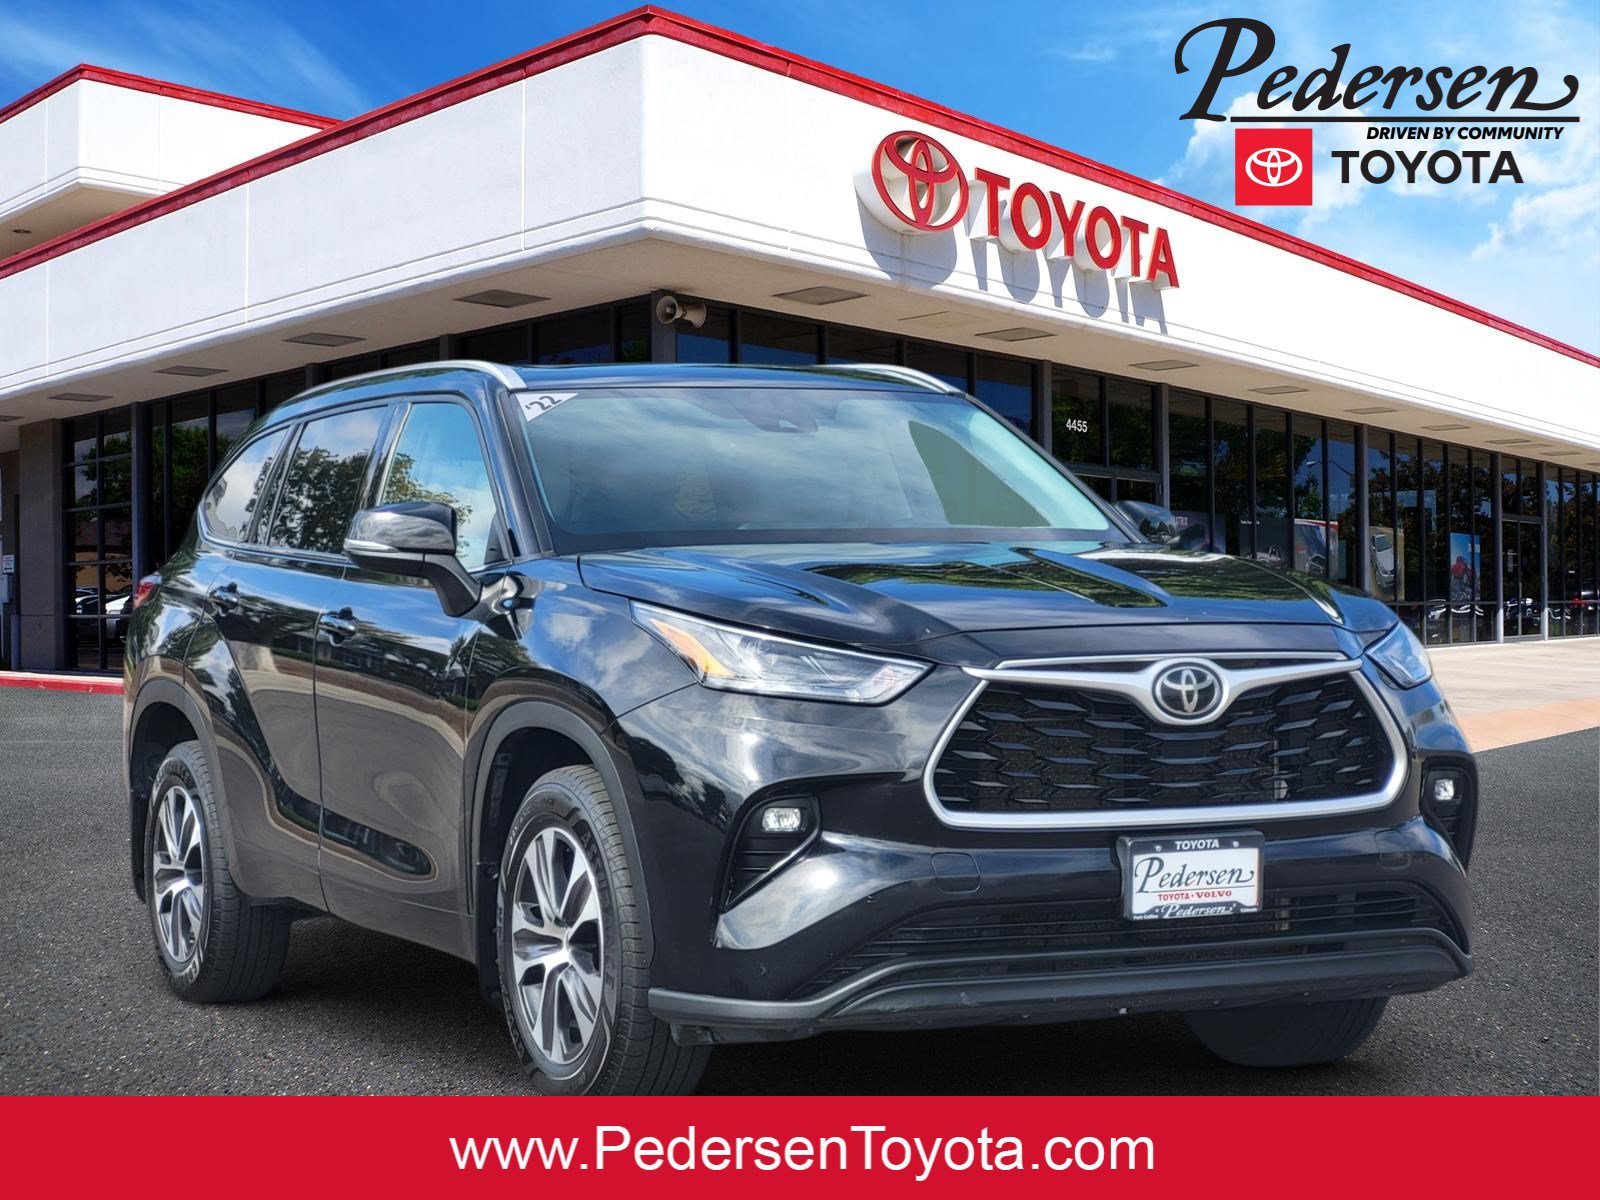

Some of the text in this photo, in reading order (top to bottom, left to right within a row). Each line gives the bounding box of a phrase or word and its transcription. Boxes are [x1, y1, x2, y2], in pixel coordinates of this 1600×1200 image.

[974, 167, 1180, 289] TOYOTA
[1065, 418, 1088, 433] 4455
[1174, 838, 1220, 851] TOYOTA
[1134, 856, 1256, 894] Pedersen
[1157, 890, 1232, 902] TOYOTA VOLVO
[1160, 903, 1234, 919] Pedersen
